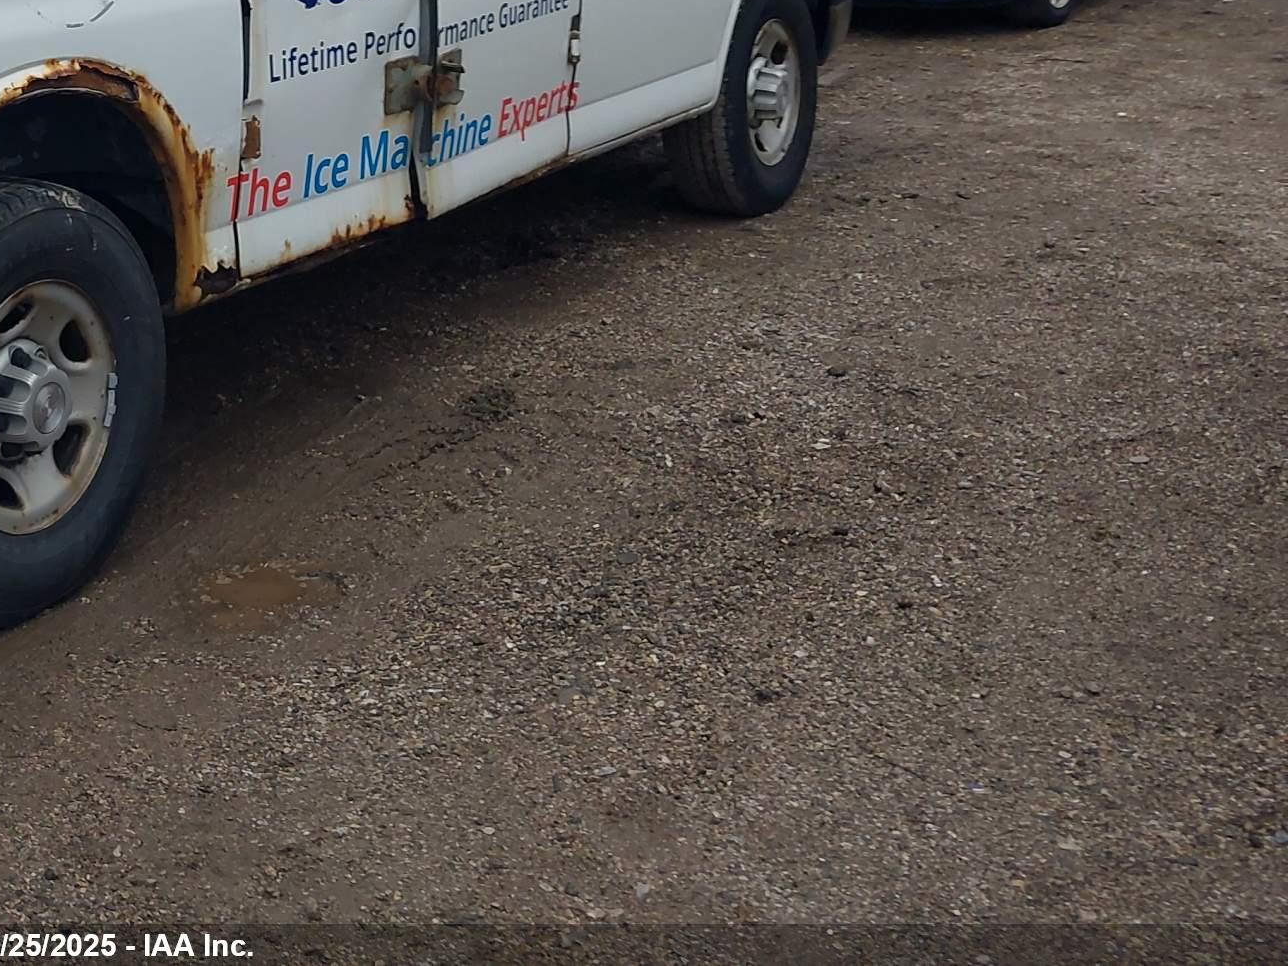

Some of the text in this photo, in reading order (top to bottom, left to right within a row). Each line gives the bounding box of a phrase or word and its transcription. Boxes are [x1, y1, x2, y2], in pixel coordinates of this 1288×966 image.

[268, 41, 358, 84] Lifetime
[364, 11, 495, 60] Performance
[226, 80, 580, 222] The Ice Machine Experts
